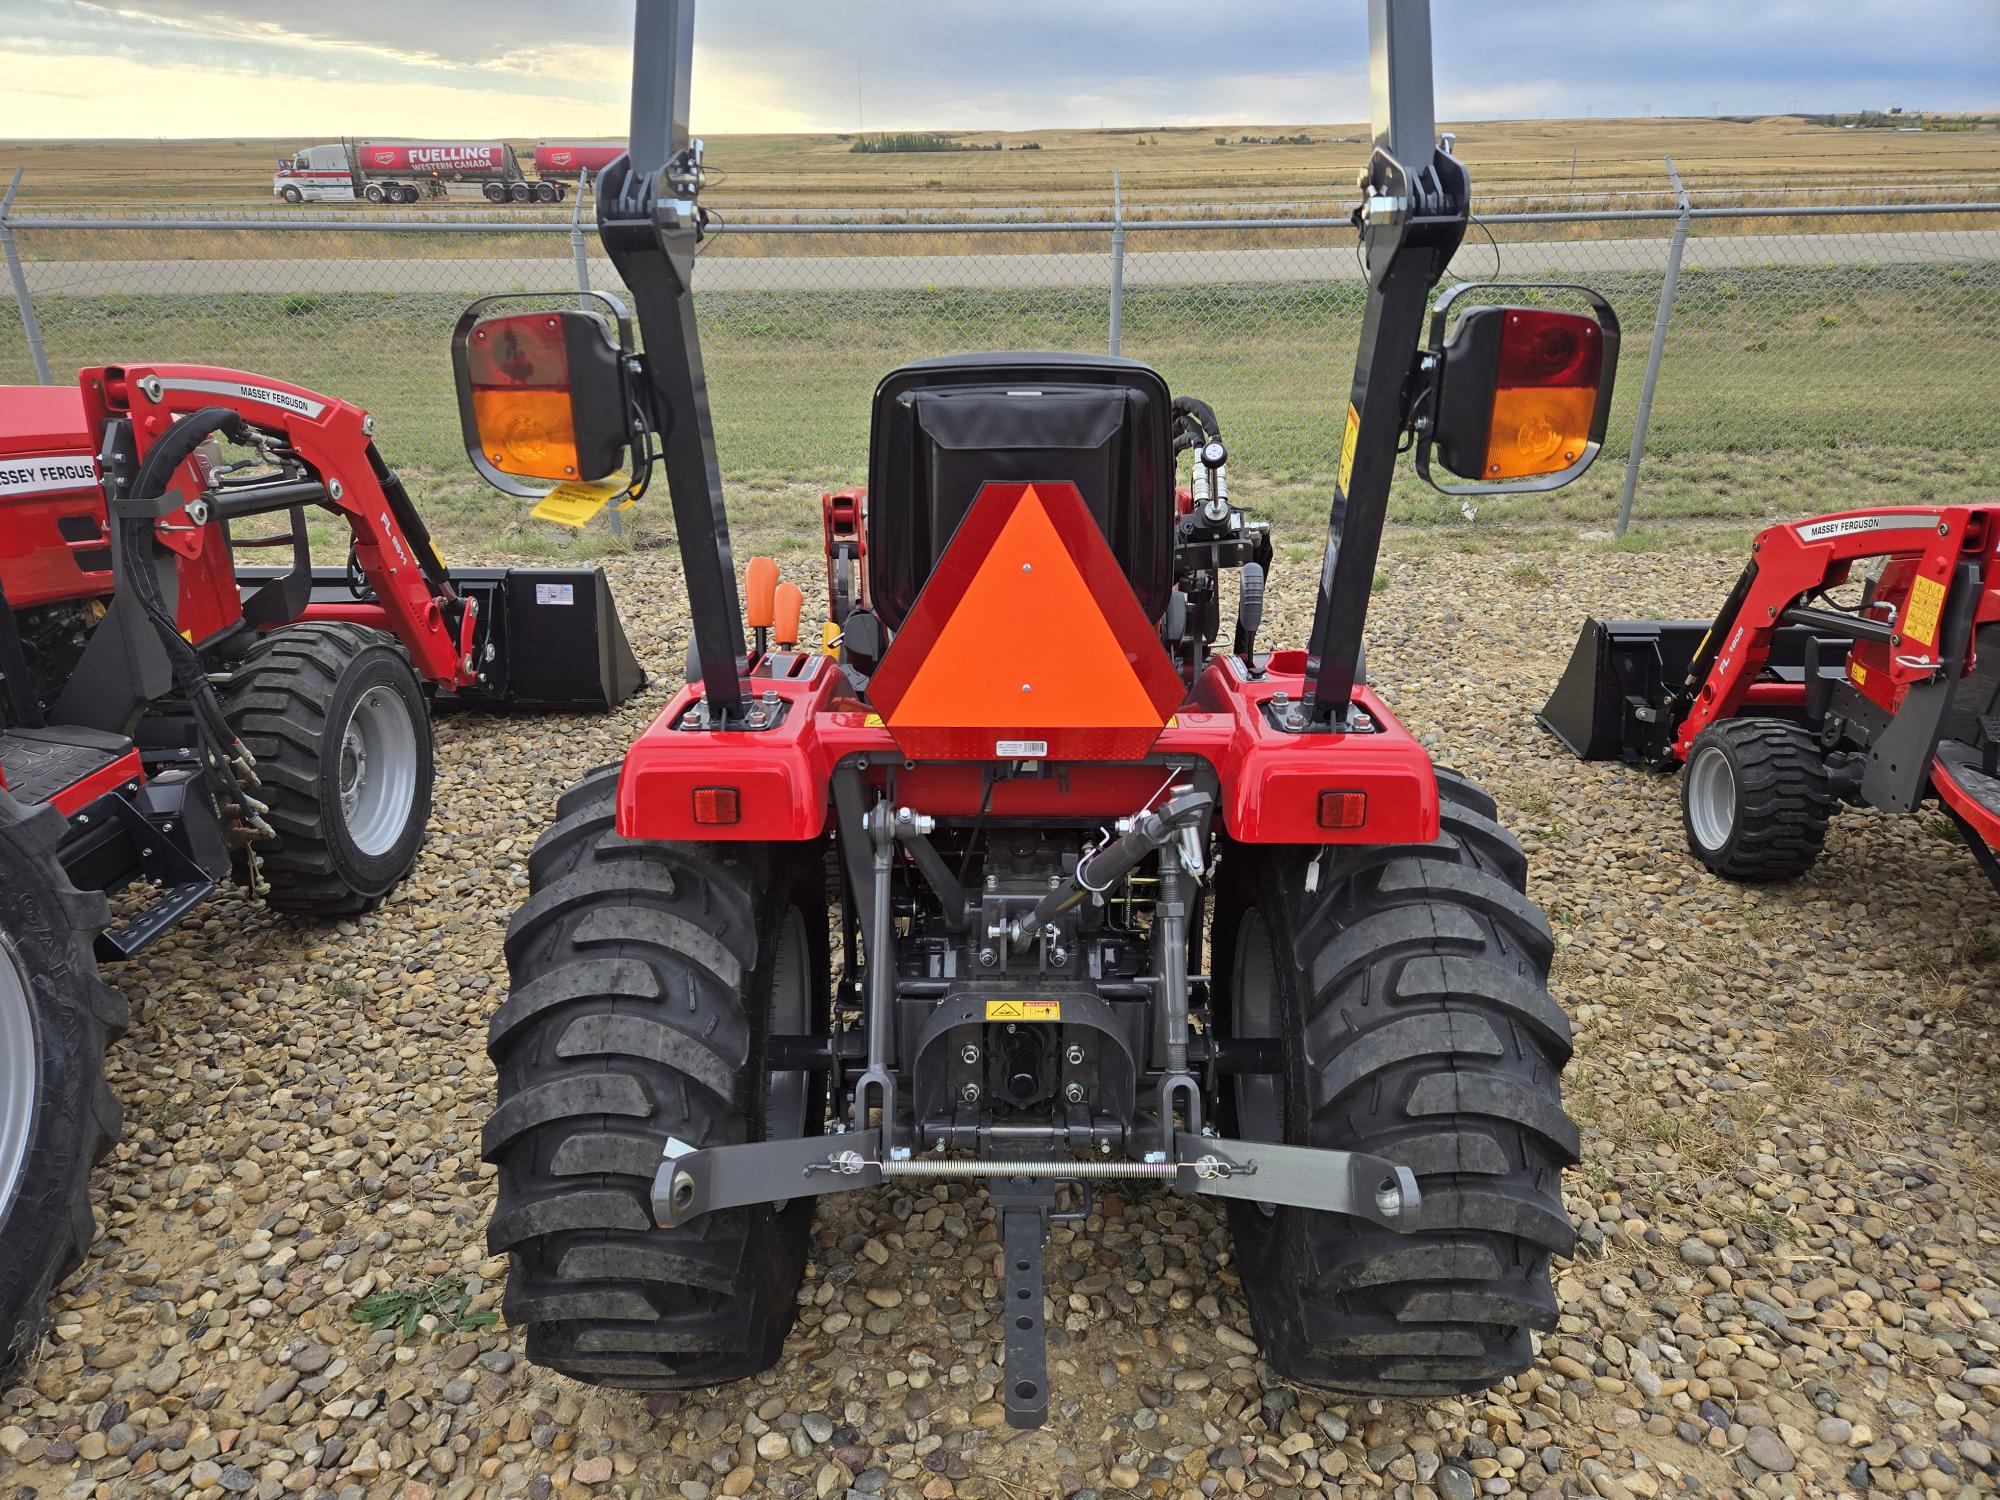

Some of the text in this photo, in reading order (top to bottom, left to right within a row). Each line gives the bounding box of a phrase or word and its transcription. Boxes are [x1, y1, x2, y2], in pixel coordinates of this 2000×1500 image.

[408, 147, 490, 163] FUELLING
[411, 162, 453, 171] WESTERN
[454, 159, 492, 169] CANADA
[240, 386, 308, 412] MASSEY FERGUSON
[40, 464, 97, 481] FERGUS
[1811, 518, 1880, 536] MASSEY FERGUSON
[1718, 658, 1731, 676] FL
